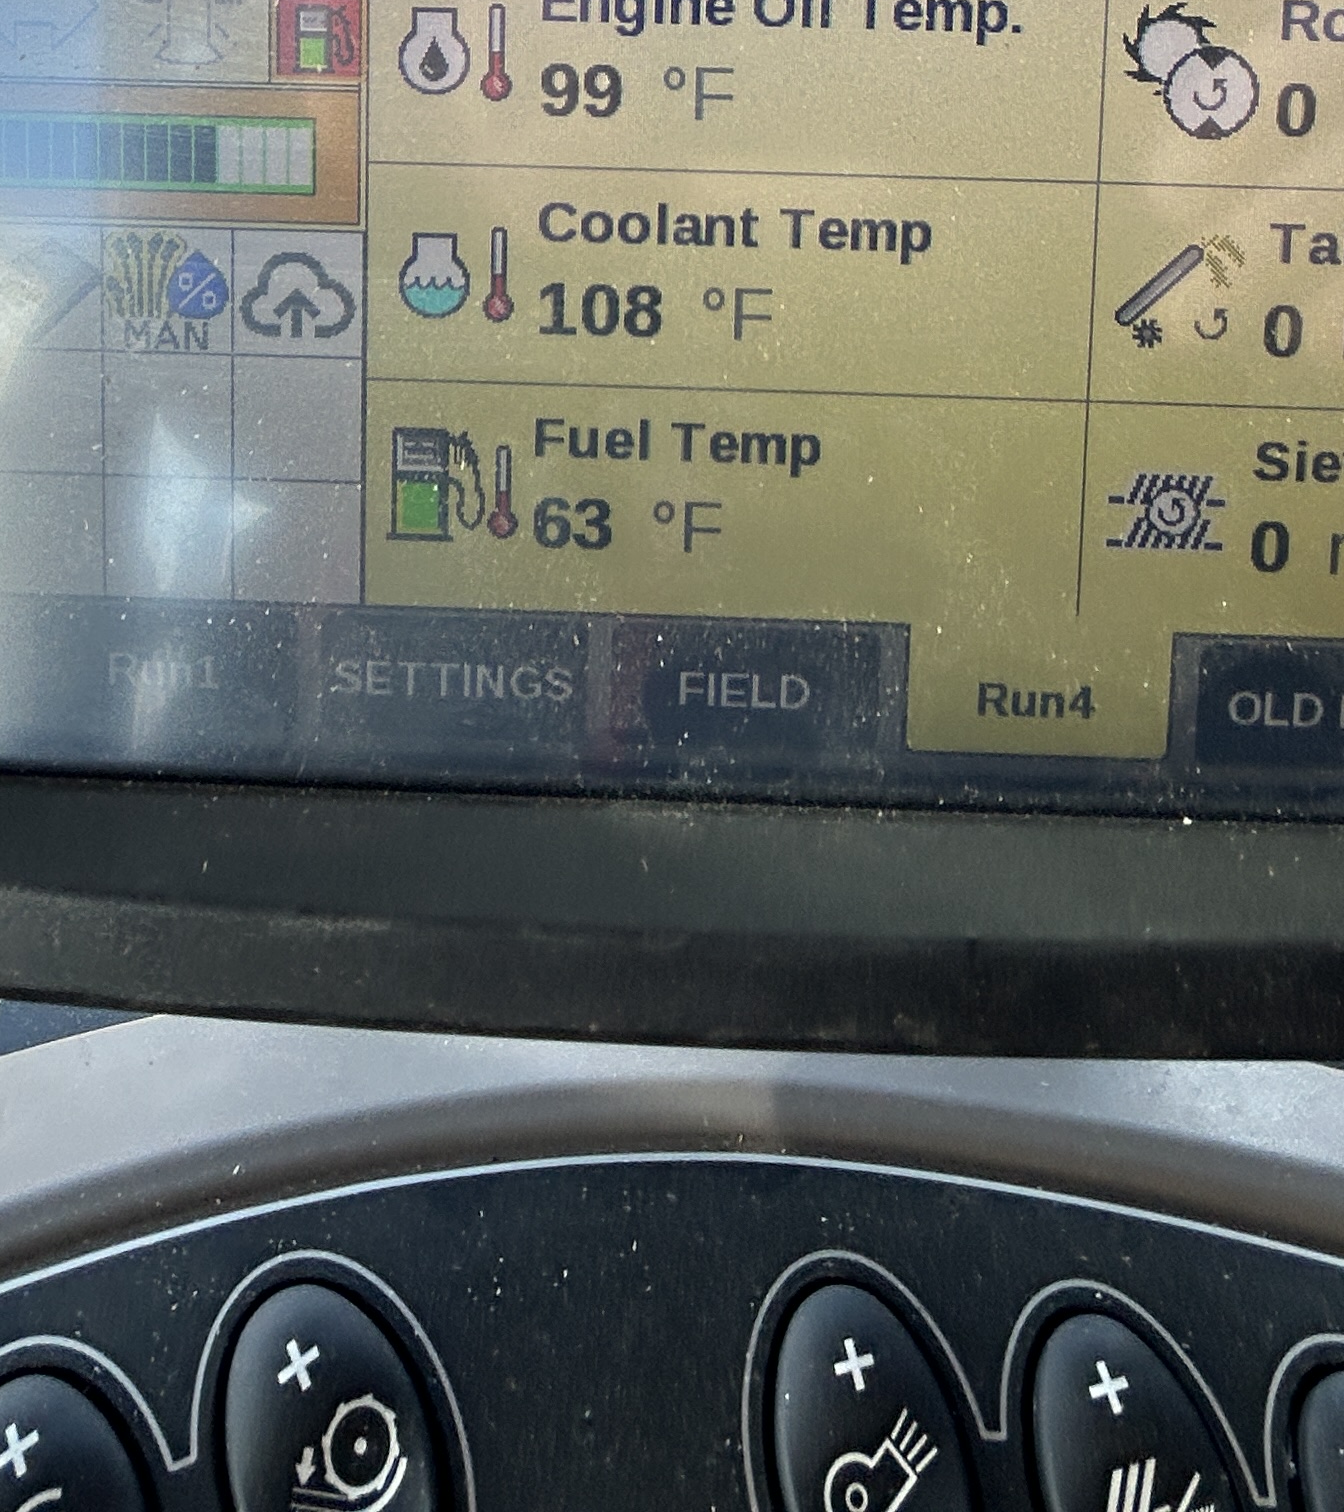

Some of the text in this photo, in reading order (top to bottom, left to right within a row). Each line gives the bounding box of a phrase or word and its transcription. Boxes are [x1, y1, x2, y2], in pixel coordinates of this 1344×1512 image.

[541, 63, 736, 121] 99 °F
[1276, 82, 1316, 137] 0
[538, 202, 933, 266] Coolant Temp
[124, 321, 210, 351] MAN
[538, 282, 774, 341] 108 °F
[1263, 304, 1303, 358] 0
[534, 417, 823, 478] Fuel Temp
[533, 497, 723, 553] 63 °F
[1251, 520, 1290, 575] 0
[108, 651, 219, 690] Run1
[333, 658, 574, 704] SETTINGS
[679, 670, 810, 713] FIELD
[976, 681, 1096, 722] Run4
[1228, 689, 1323, 732] OLD
